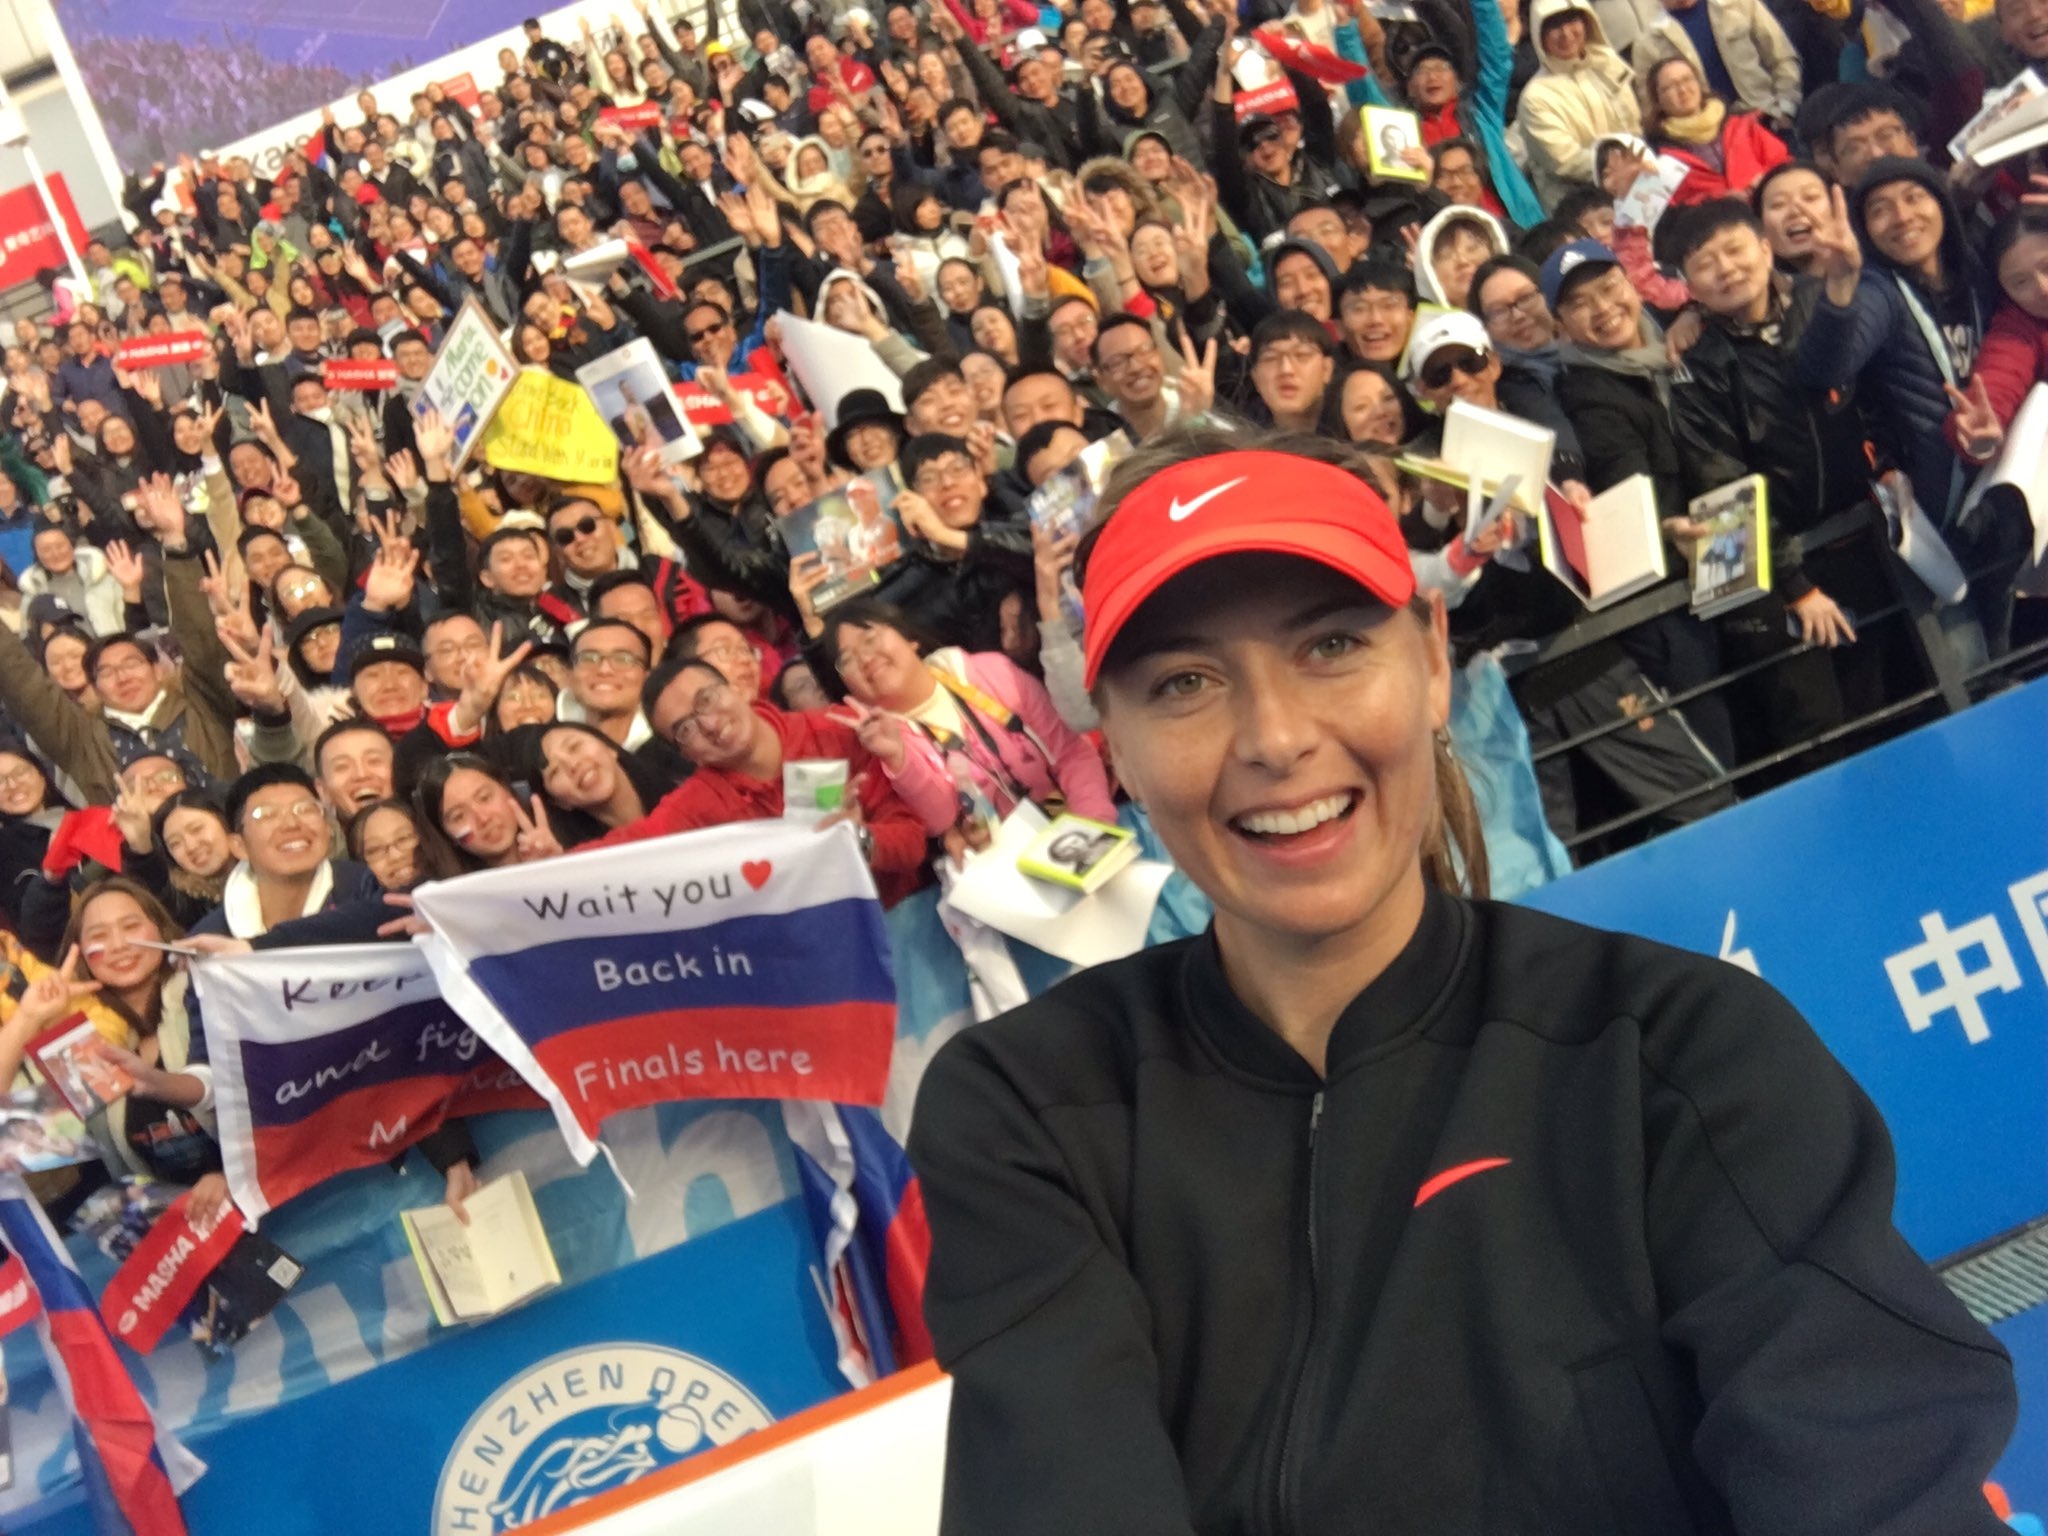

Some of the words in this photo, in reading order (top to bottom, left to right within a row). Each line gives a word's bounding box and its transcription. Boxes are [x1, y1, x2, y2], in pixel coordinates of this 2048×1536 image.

[523, 884, 637, 922] Wait
[653, 871, 732, 917] you
[593, 950, 702, 993] Back
[713, 945, 754, 977] in
[415, 1019, 480, 1062] fig
[573, 1041, 706, 1103] Finals
[715, 1038, 814, 1077] here
[131, 1234, 196, 1312] MASHA
[451, 1362, 625, 1529] HENZHEN
[649, 1366, 760, 1433] OPE
